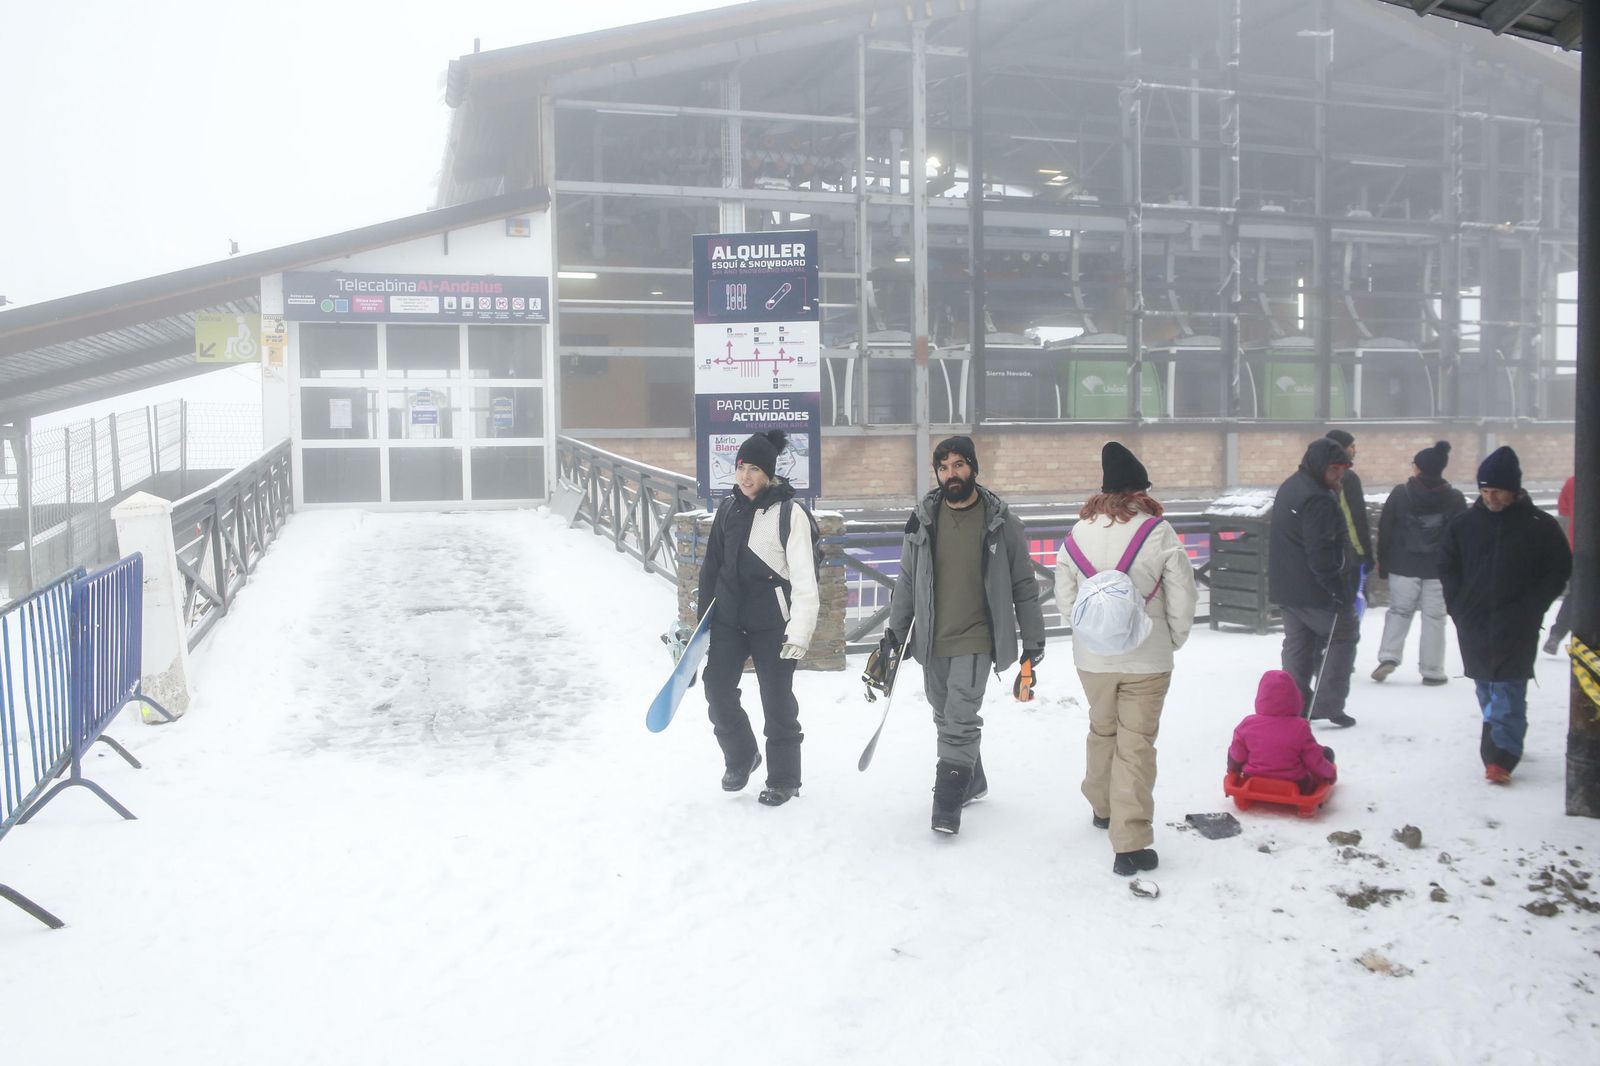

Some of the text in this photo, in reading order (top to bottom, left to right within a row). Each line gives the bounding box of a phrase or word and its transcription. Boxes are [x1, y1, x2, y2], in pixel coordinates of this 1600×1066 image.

[712, 243, 806, 261] ALQUILER
[711, 260, 738, 269] ESQUÍ
[748, 259, 806, 269] SNOWBOARD
[336, 278, 503, 293] Telecabina Al-Andalus
[716, 399, 790, 411] PARQUE DE
[732, 412, 810, 422] ACTIVIDADES
